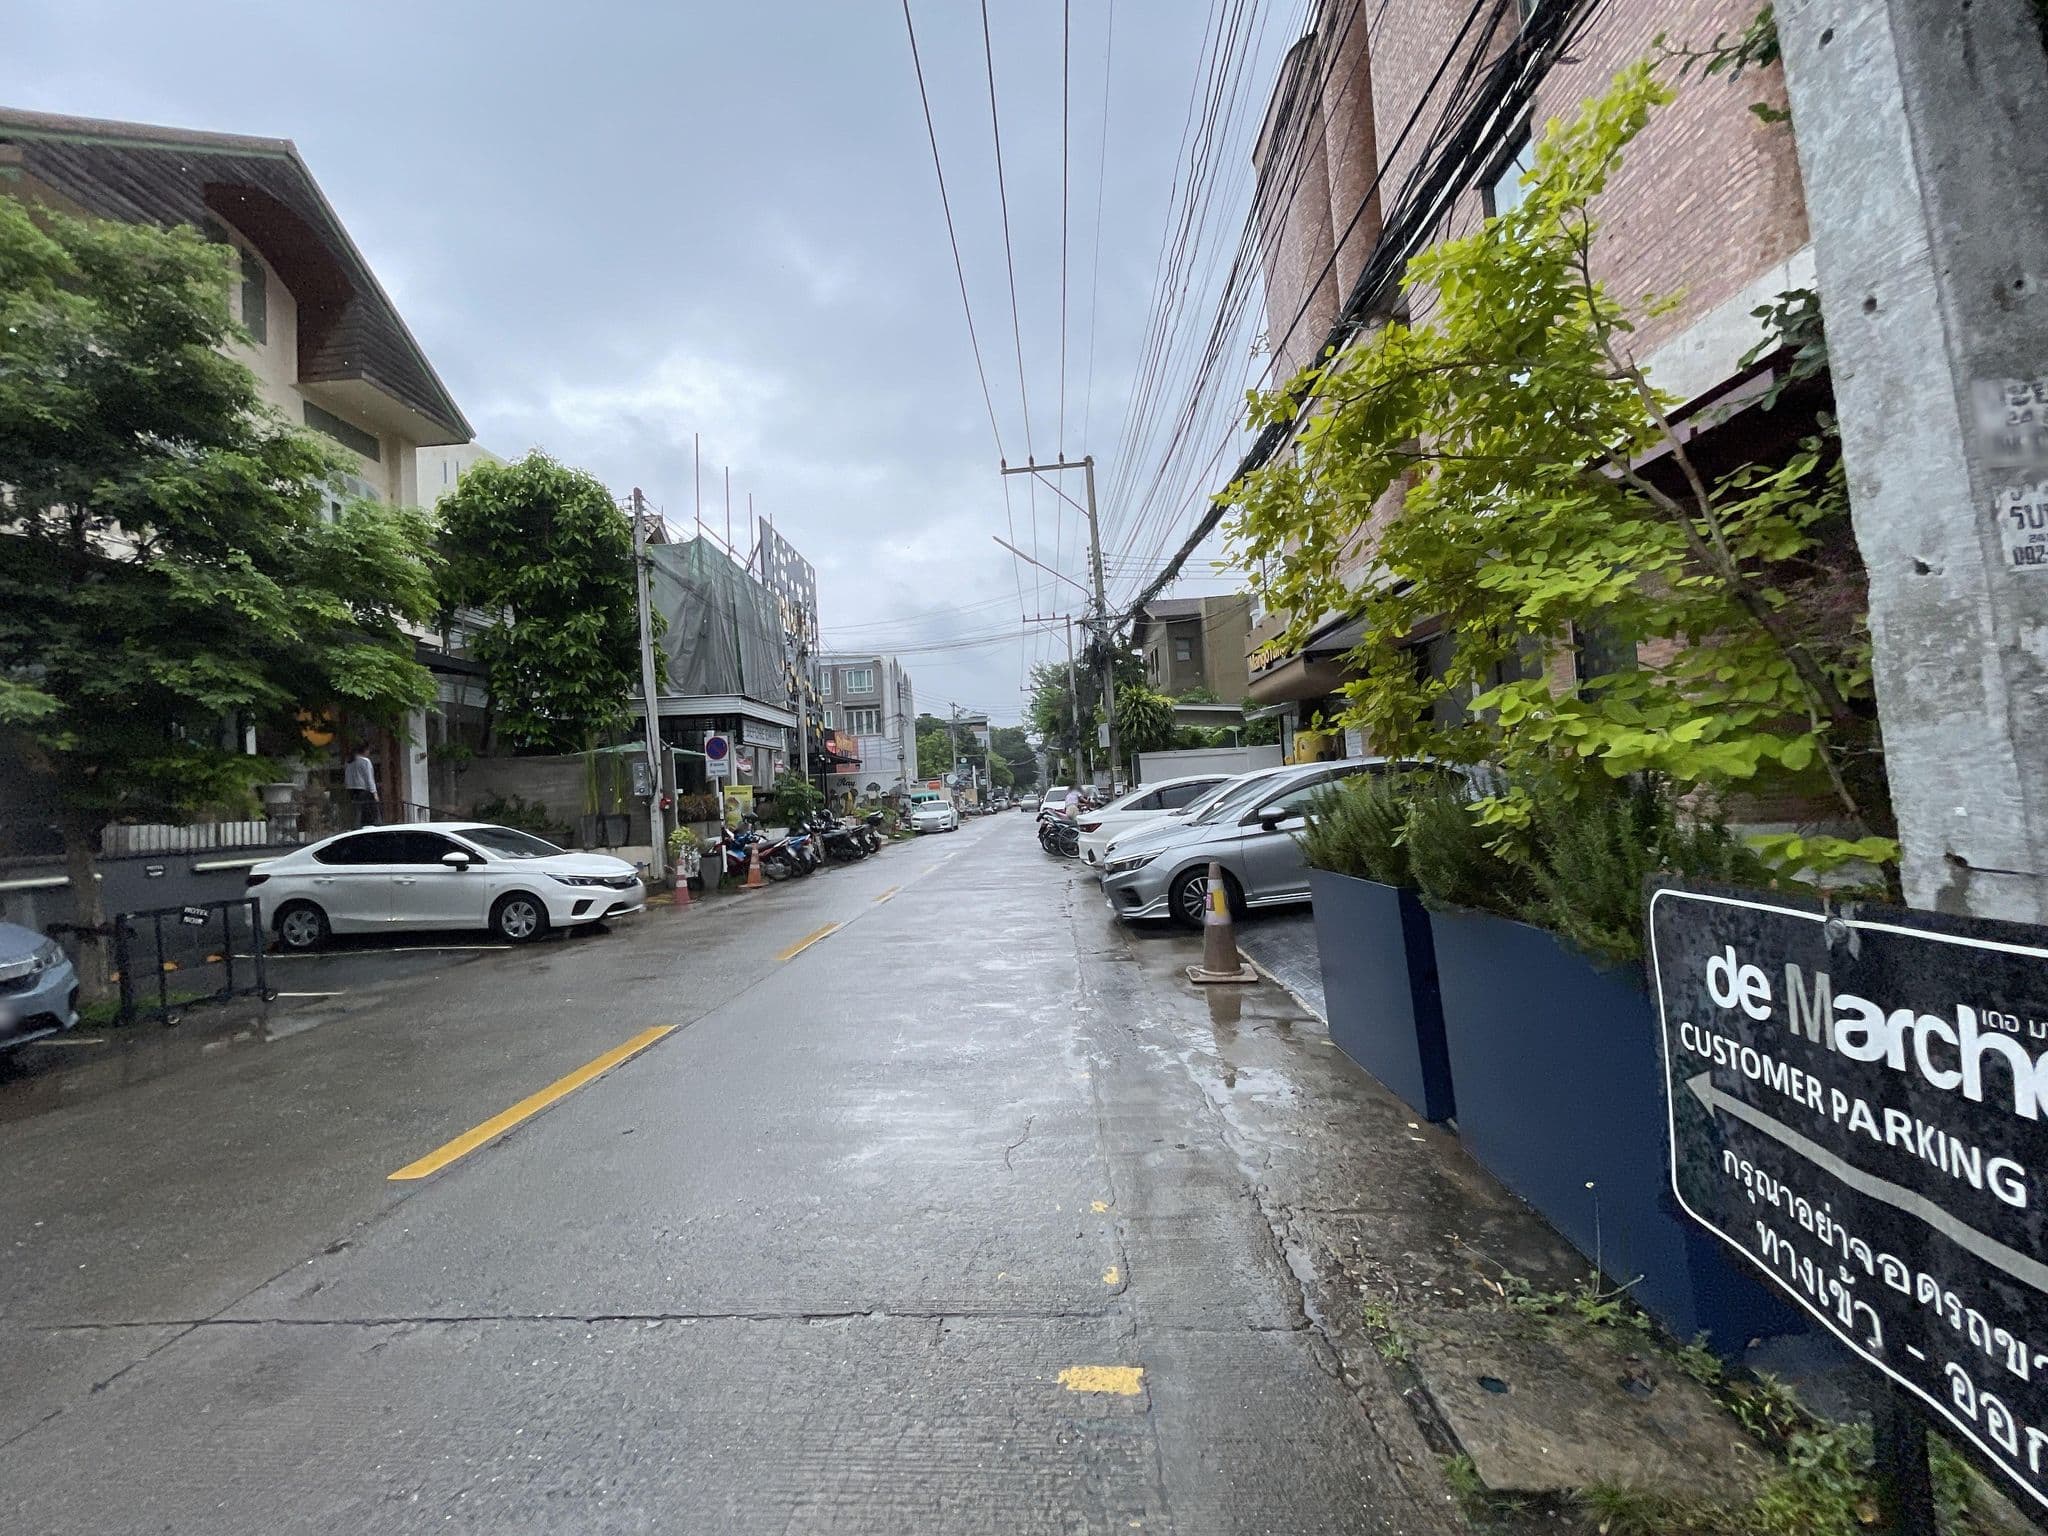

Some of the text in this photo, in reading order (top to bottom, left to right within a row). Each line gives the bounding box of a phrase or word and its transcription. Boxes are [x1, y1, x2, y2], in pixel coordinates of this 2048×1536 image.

[1706, 945, 1772, 1021] de
[1680, 1022, 2028, 1208] CUSTOMER PARKING
